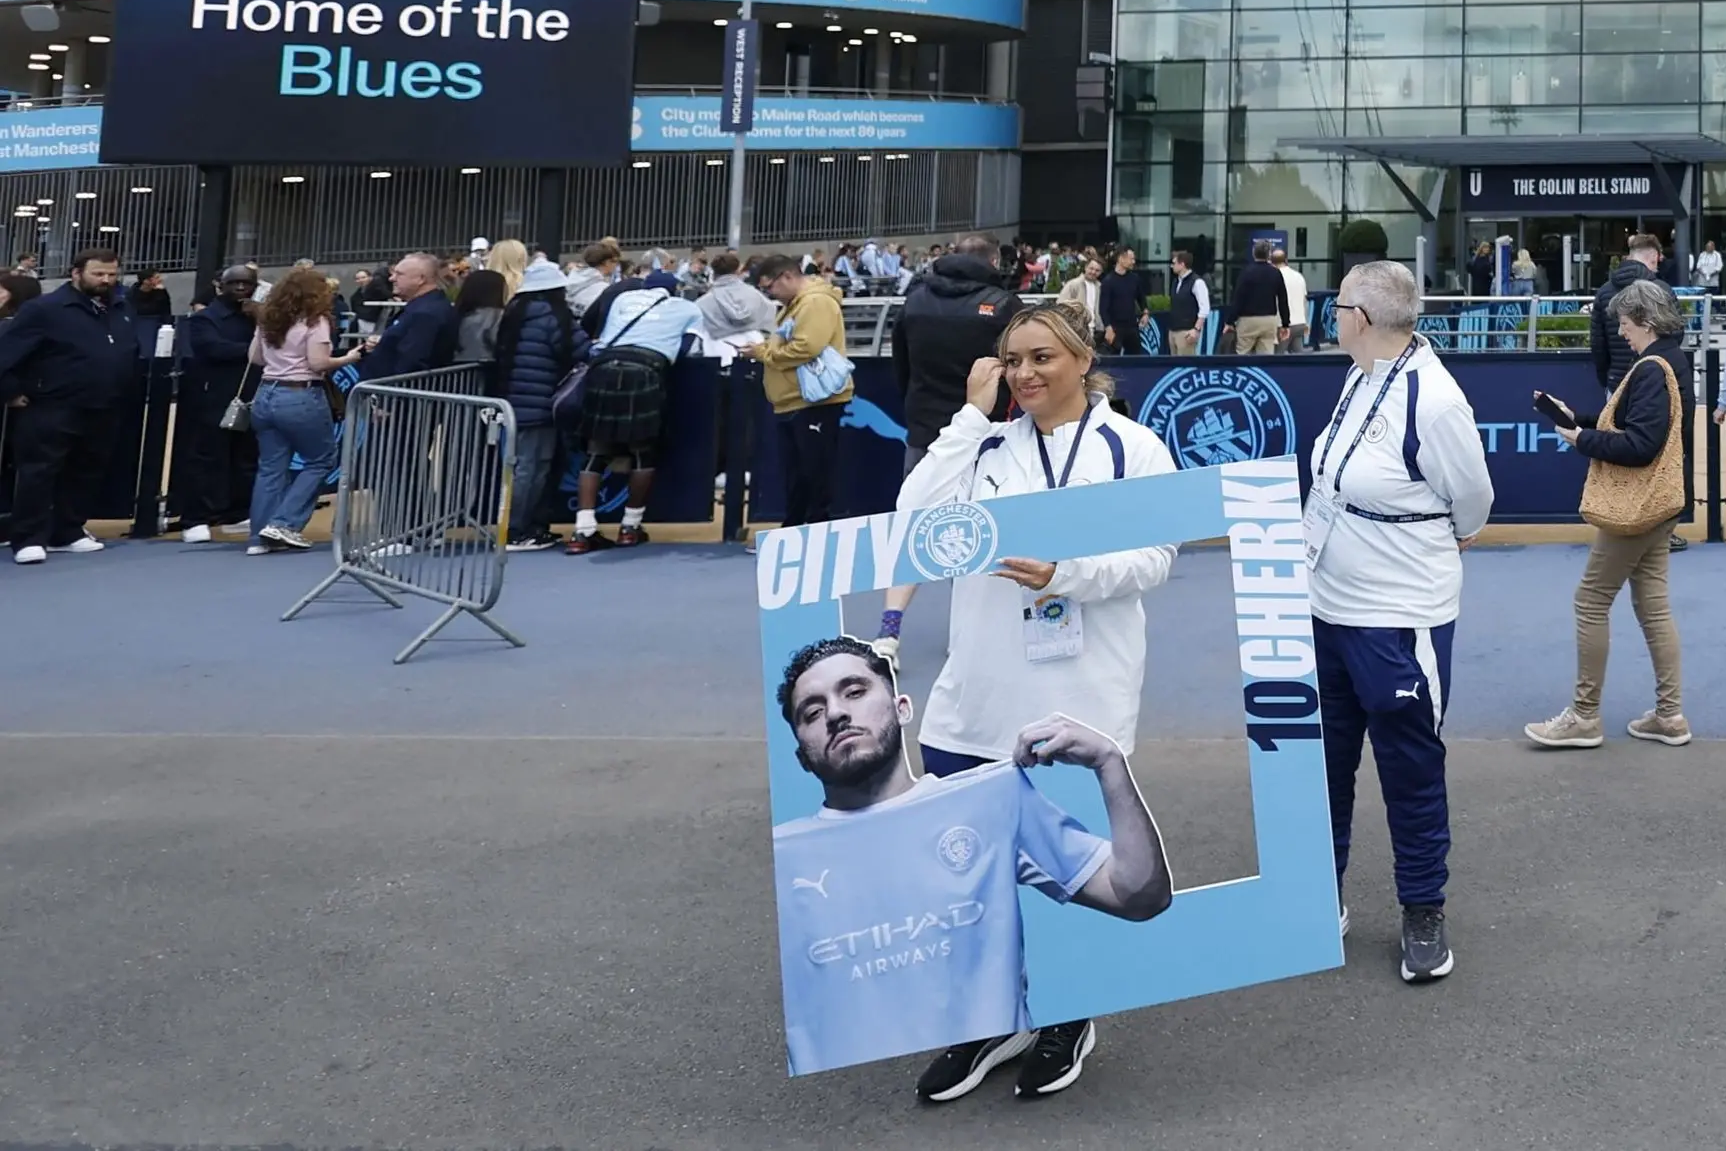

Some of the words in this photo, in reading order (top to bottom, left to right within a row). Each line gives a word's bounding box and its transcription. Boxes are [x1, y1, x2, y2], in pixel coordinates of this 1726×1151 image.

[735, 28, 746, 60] WEST
[280, 44, 483, 100] Blues
[11, 123, 98, 139] Wanderers
[661, 108, 695, 123] City
[762, 109, 805, 122] Maine
[807, 109, 841, 122] Road
[842, 110, 879, 122] which
[661, 125, 689, 138] the
[784, 125, 802, 137] for
[805, 125, 827, 137] the
[828, 127, 855, 137] next
[877, 127, 906, 140] years
[1470, 172, 1482, 196] U
[1513, 178, 1535, 195] THE
[1539, 178, 1576, 195] COLIN
[1579, 178, 1608, 195] BELL
[1610, 177, 1650, 194] STAND
[1151, 370, 1269, 434] MANCHESTER
[1267, 418, 1281, 429] 94
[1477, 422, 1571, 452] TIH
[918, 504, 986, 535] MANCHESTER
[757, 510, 912, 610] CITY
[943, 566, 969, 577] CITY
[1220, 459, 1317, 678] CHERKI
[1243, 680, 1322, 752] 10
[808, 900, 984, 964] ETIHAD
[850, 940, 952, 981] AIRWAYS
